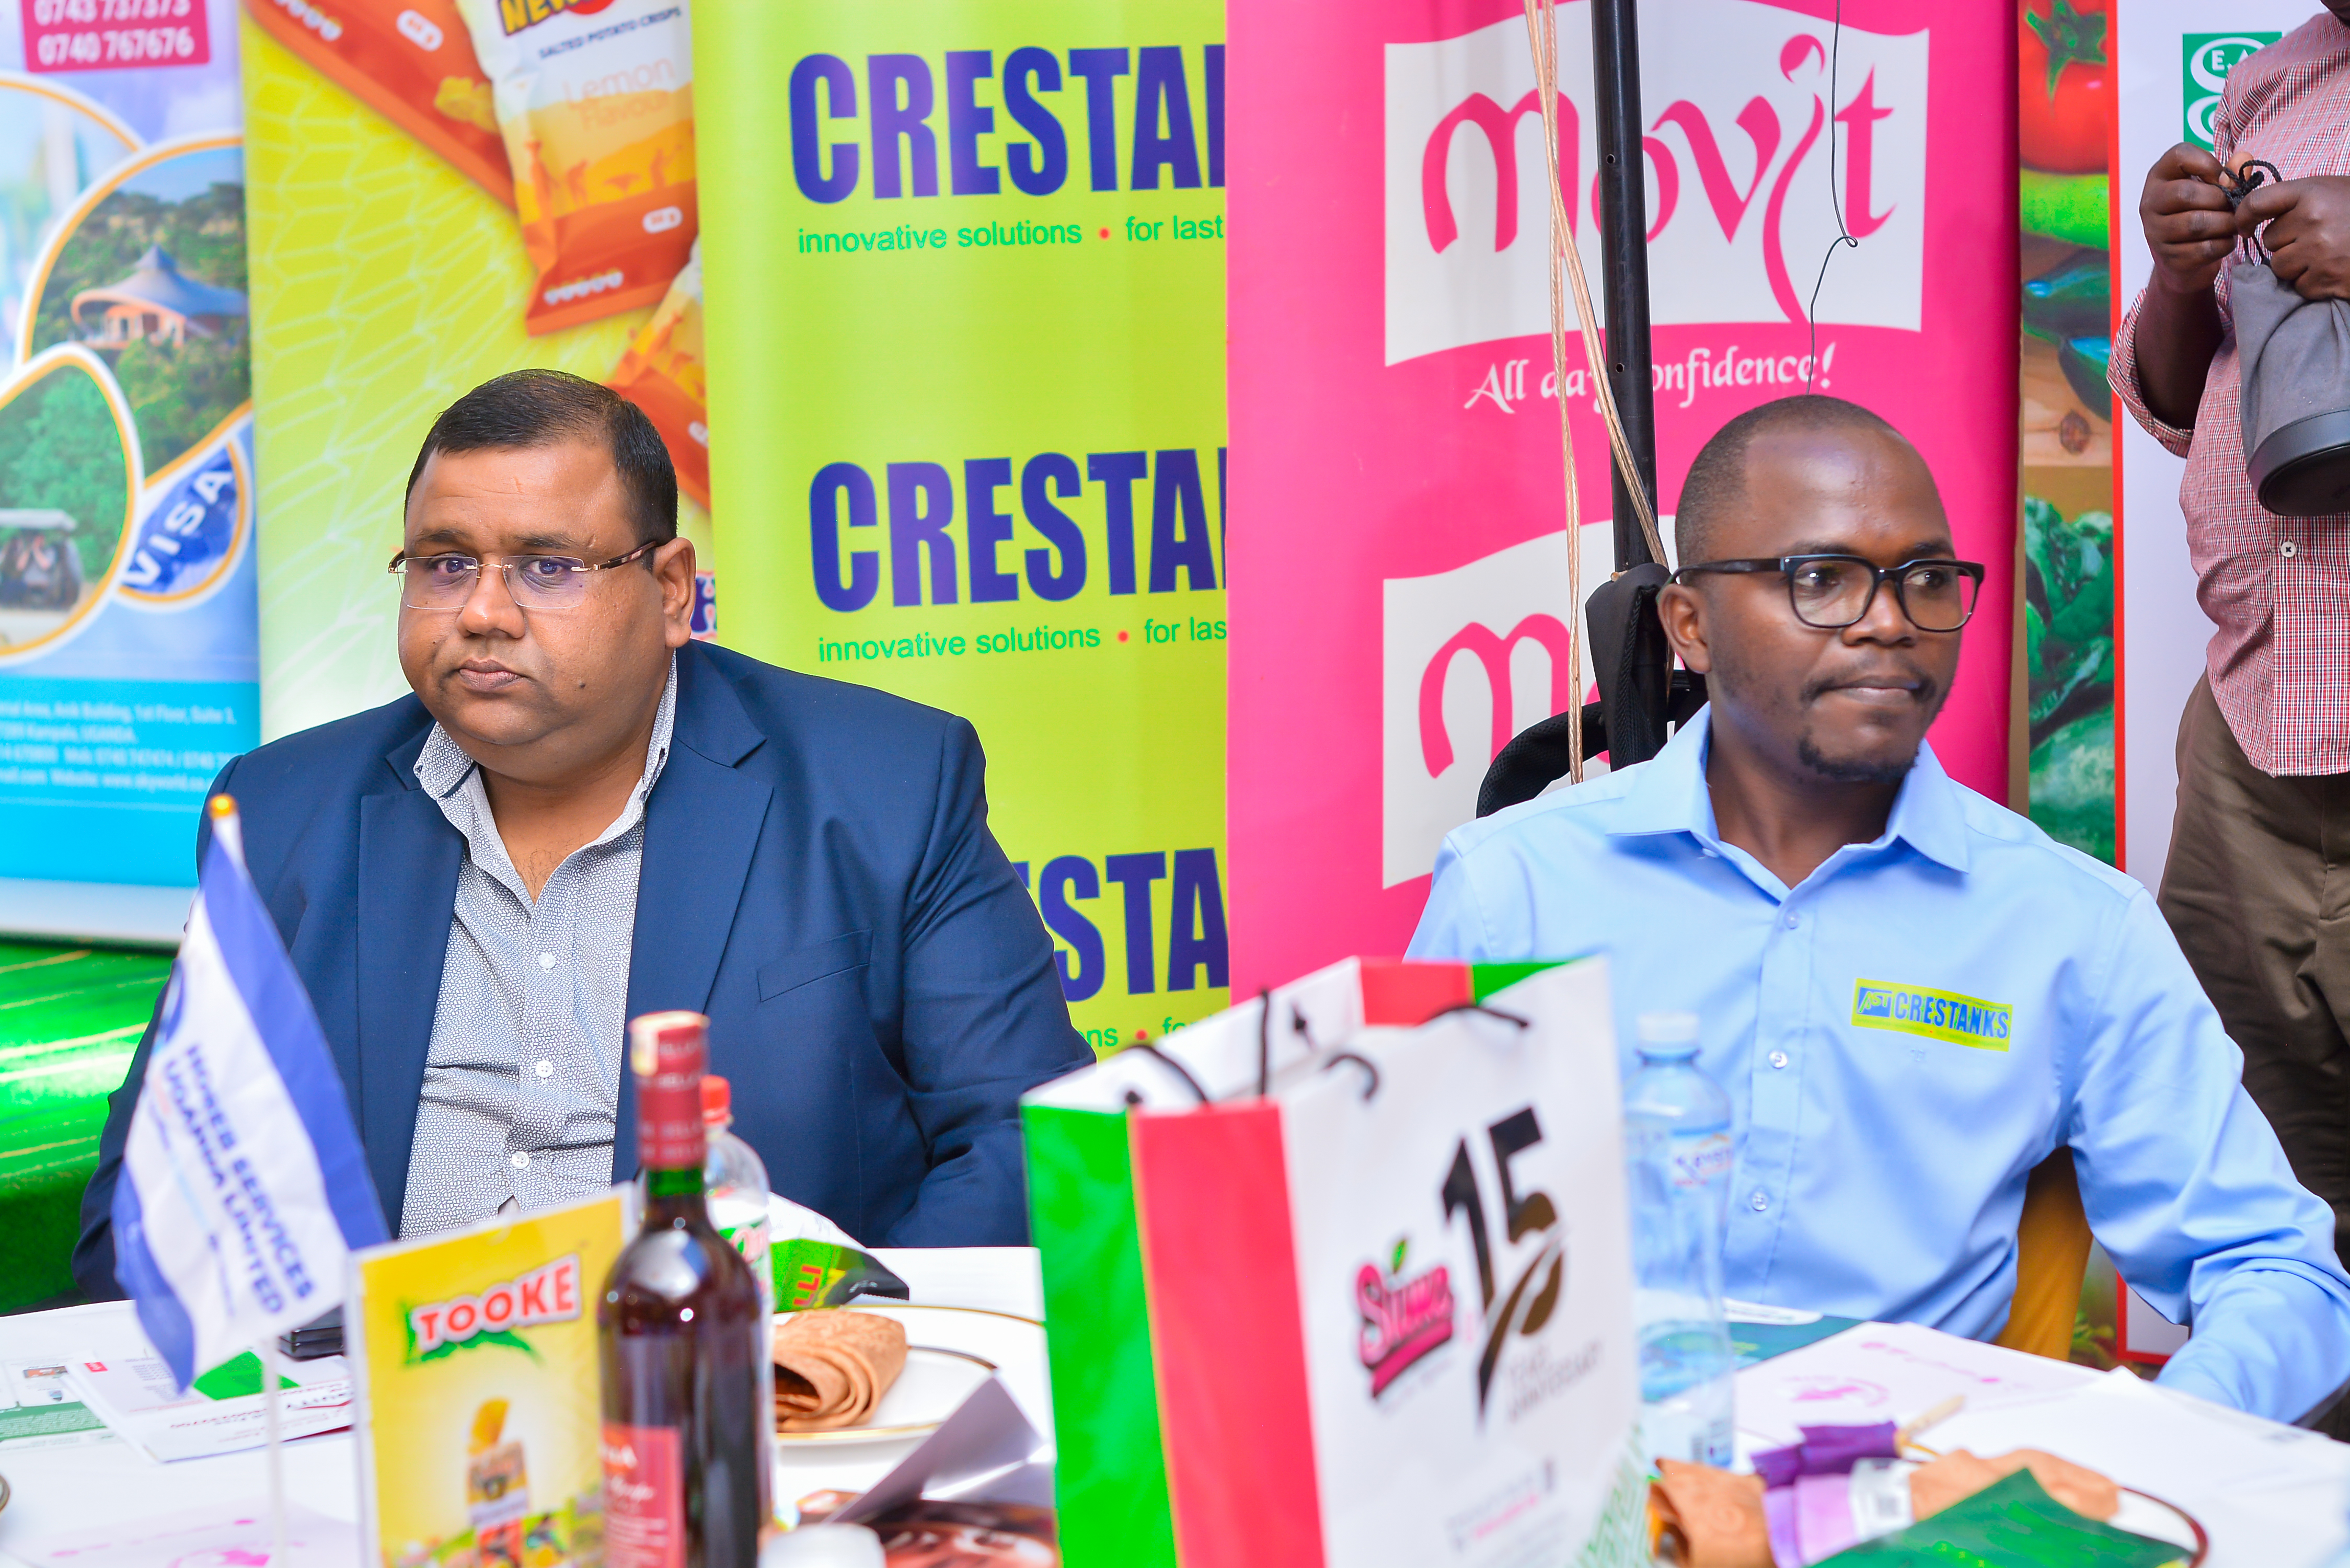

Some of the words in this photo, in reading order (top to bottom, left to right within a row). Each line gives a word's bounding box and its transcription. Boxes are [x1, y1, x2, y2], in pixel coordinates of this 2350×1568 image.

[38, 32, 102, 66] 0740
[102, 26, 195, 62] 767676
[588, 19, 637, 42] POTATO
[640, 6, 683, 28] CRISPS
[563, 57, 675, 109] Lemon
[798, 223, 947, 253] innovative
[958, 220, 1082, 248] solutions
[1126, 216, 1164, 242] for
[1173, 215, 1224, 240] last
[1464, 359, 1529, 414] All
[1652, 341, 1836, 408] onfidence!
[121, 471, 235, 585] VISA
[809, 447, 1227, 613] CRESTA
[819, 632, 966, 663] innovative
[976, 626, 1101, 654] solutions
[1145, 619, 1181, 644] for
[1895, 992, 2009, 1039] CRESTANKS
[233, 1157, 316, 1299] SERVICES
[418, 1262, 574, 1341] TOOKE
